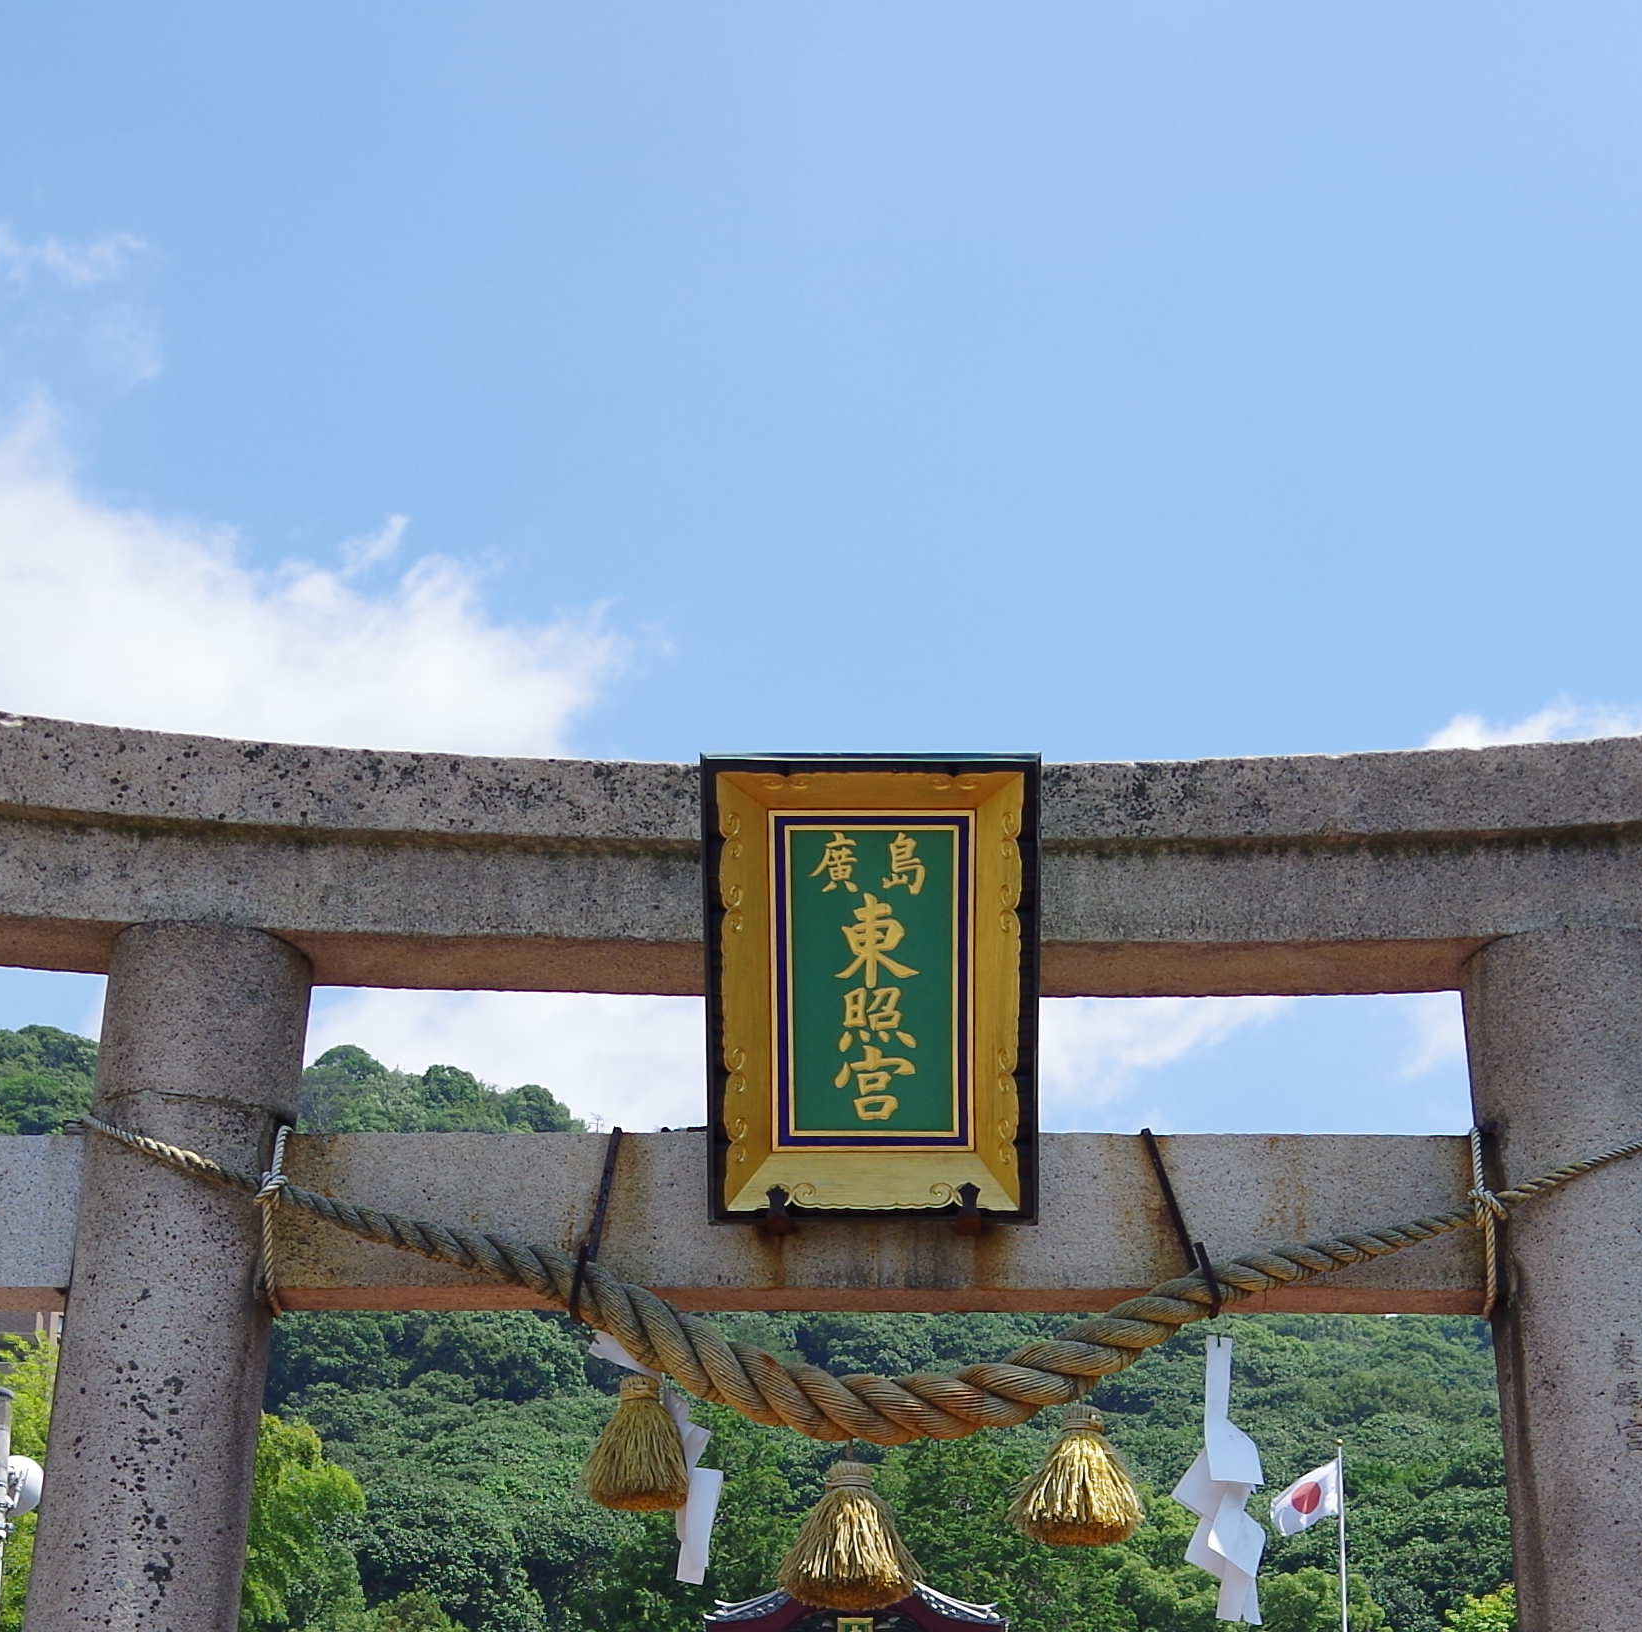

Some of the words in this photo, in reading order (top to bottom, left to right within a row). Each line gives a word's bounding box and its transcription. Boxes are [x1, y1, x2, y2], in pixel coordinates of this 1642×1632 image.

[809, 831, 927, 896] 廣島
[834, 892, 921, 1121] 東照宮
